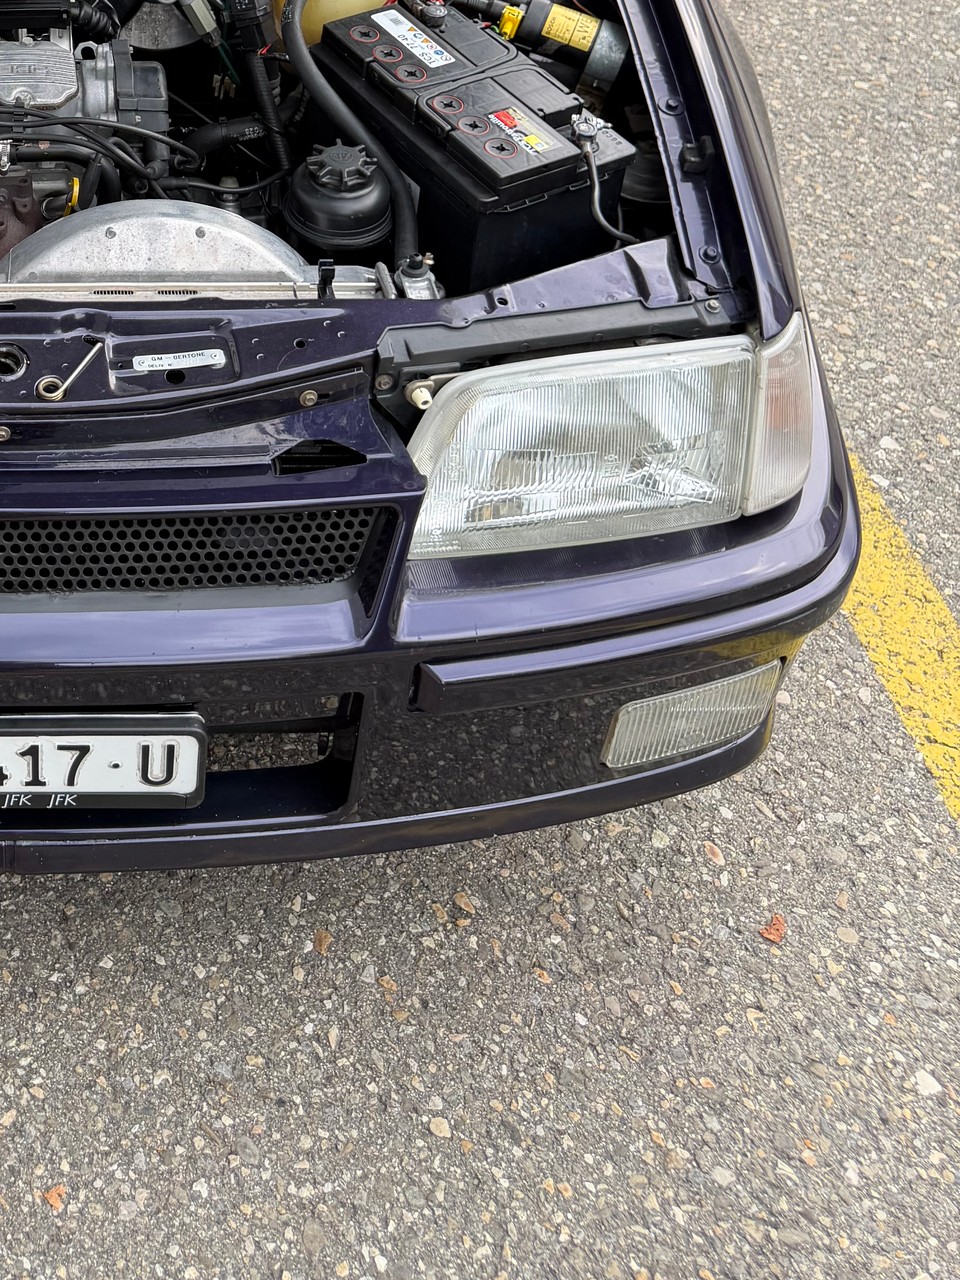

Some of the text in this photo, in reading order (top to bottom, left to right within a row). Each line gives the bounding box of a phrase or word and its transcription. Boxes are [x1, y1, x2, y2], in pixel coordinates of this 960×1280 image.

[172, 352, 206, 360] BERTONE
[141, 744, 176, 787] U
[2, 794, 33, 809] JFK
[47, 794, 78, 809] JFK
